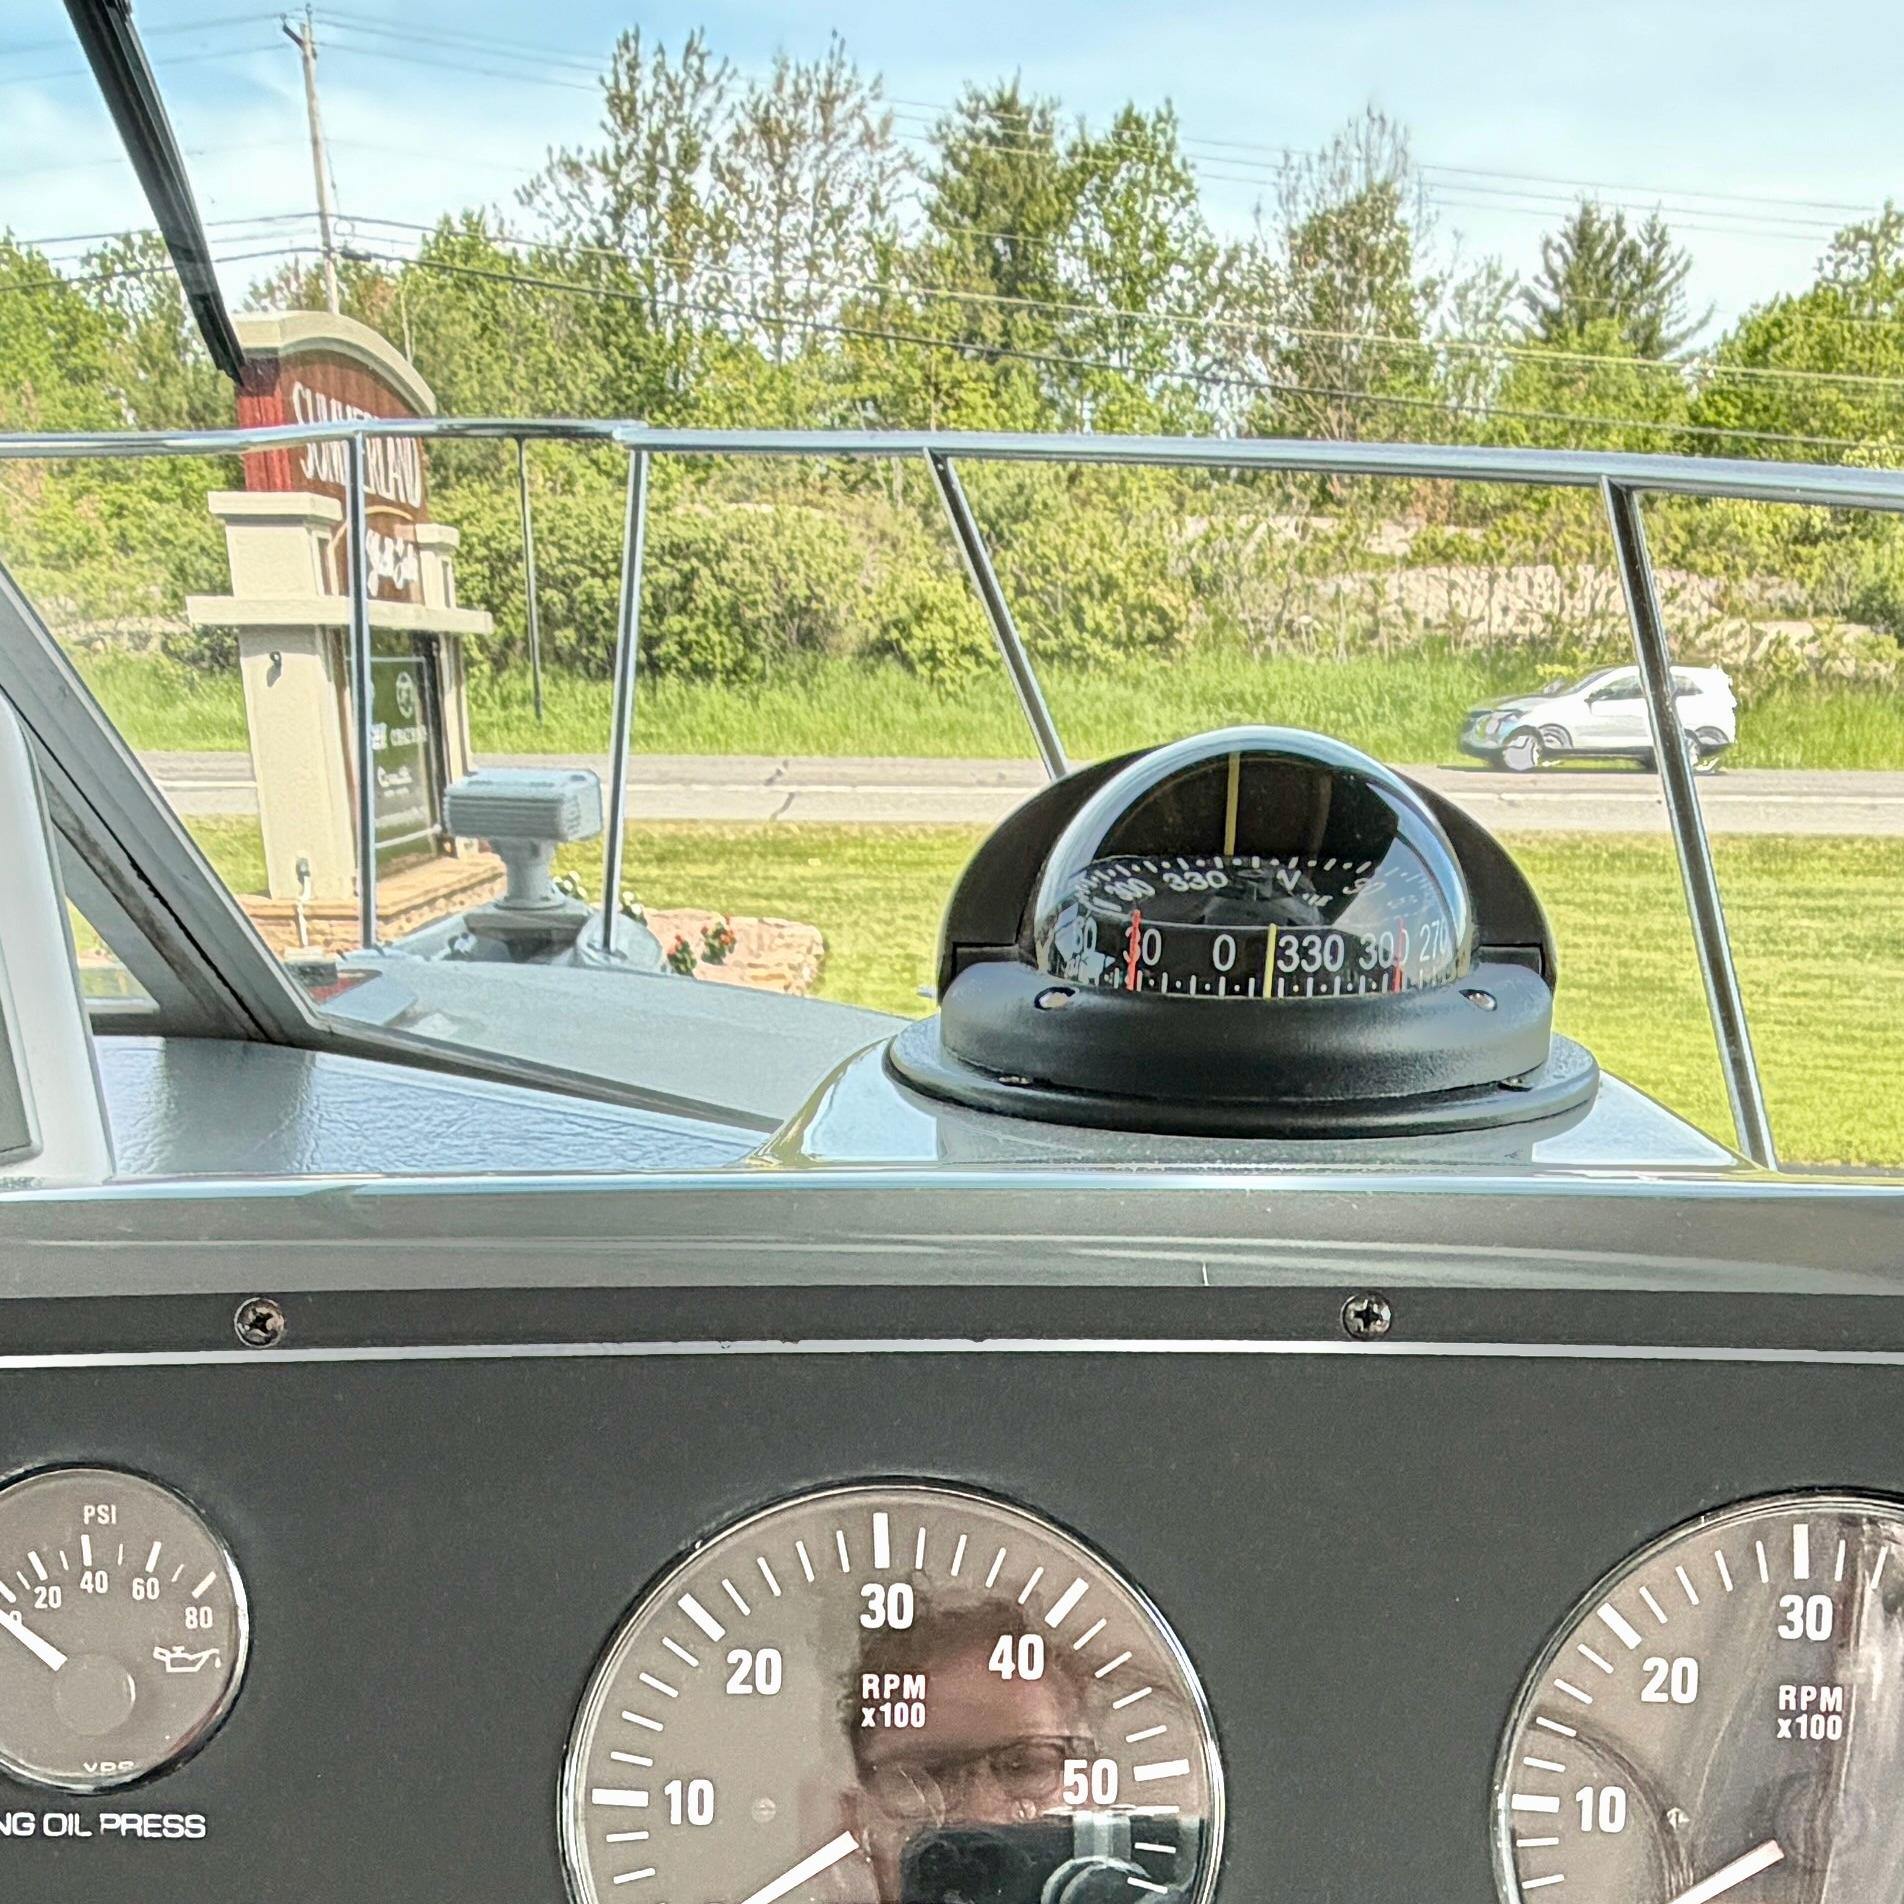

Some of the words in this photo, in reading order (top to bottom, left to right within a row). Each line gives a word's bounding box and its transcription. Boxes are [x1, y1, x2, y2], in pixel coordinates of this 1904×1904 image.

[1163, 870, 1228, 890] 330
[1212, 934, 1236, 972] 0
[1277, 934, 1344, 972] 330
[1359, 931, 1409, 966] 300
[1419, 919, 1449, 962] 270
[83, 1505, 116, 1524] PSI
[34, 1586, 62, 1609] 20
[80, 1570, 108, 1594] 40
[132, 1577, 160, 1600] 60
[185, 1606, 213, 1629] 80
[860, 1583, 914, 1629] 30
[1778, 1594, 1833, 1640] 30
[726, 1649, 783, 1695] 20
[988, 1635, 1045, 1681] 40
[862, 1675, 926, 1700] RPM
[1641, 1657, 1698, 1704] 20
[1778, 1685, 1843, 1711] RPM
[861, 1703, 926, 1728] x100
[1777, 1716, 1842, 1740] x100
[1062, 1759, 1118, 1805] 50
[664, 1779, 715, 1826] 10
[1575, 1786, 1626, 1833] 10
[43, 1812, 92, 1837] OIL
[100, 1813, 206, 1839] PRESS
